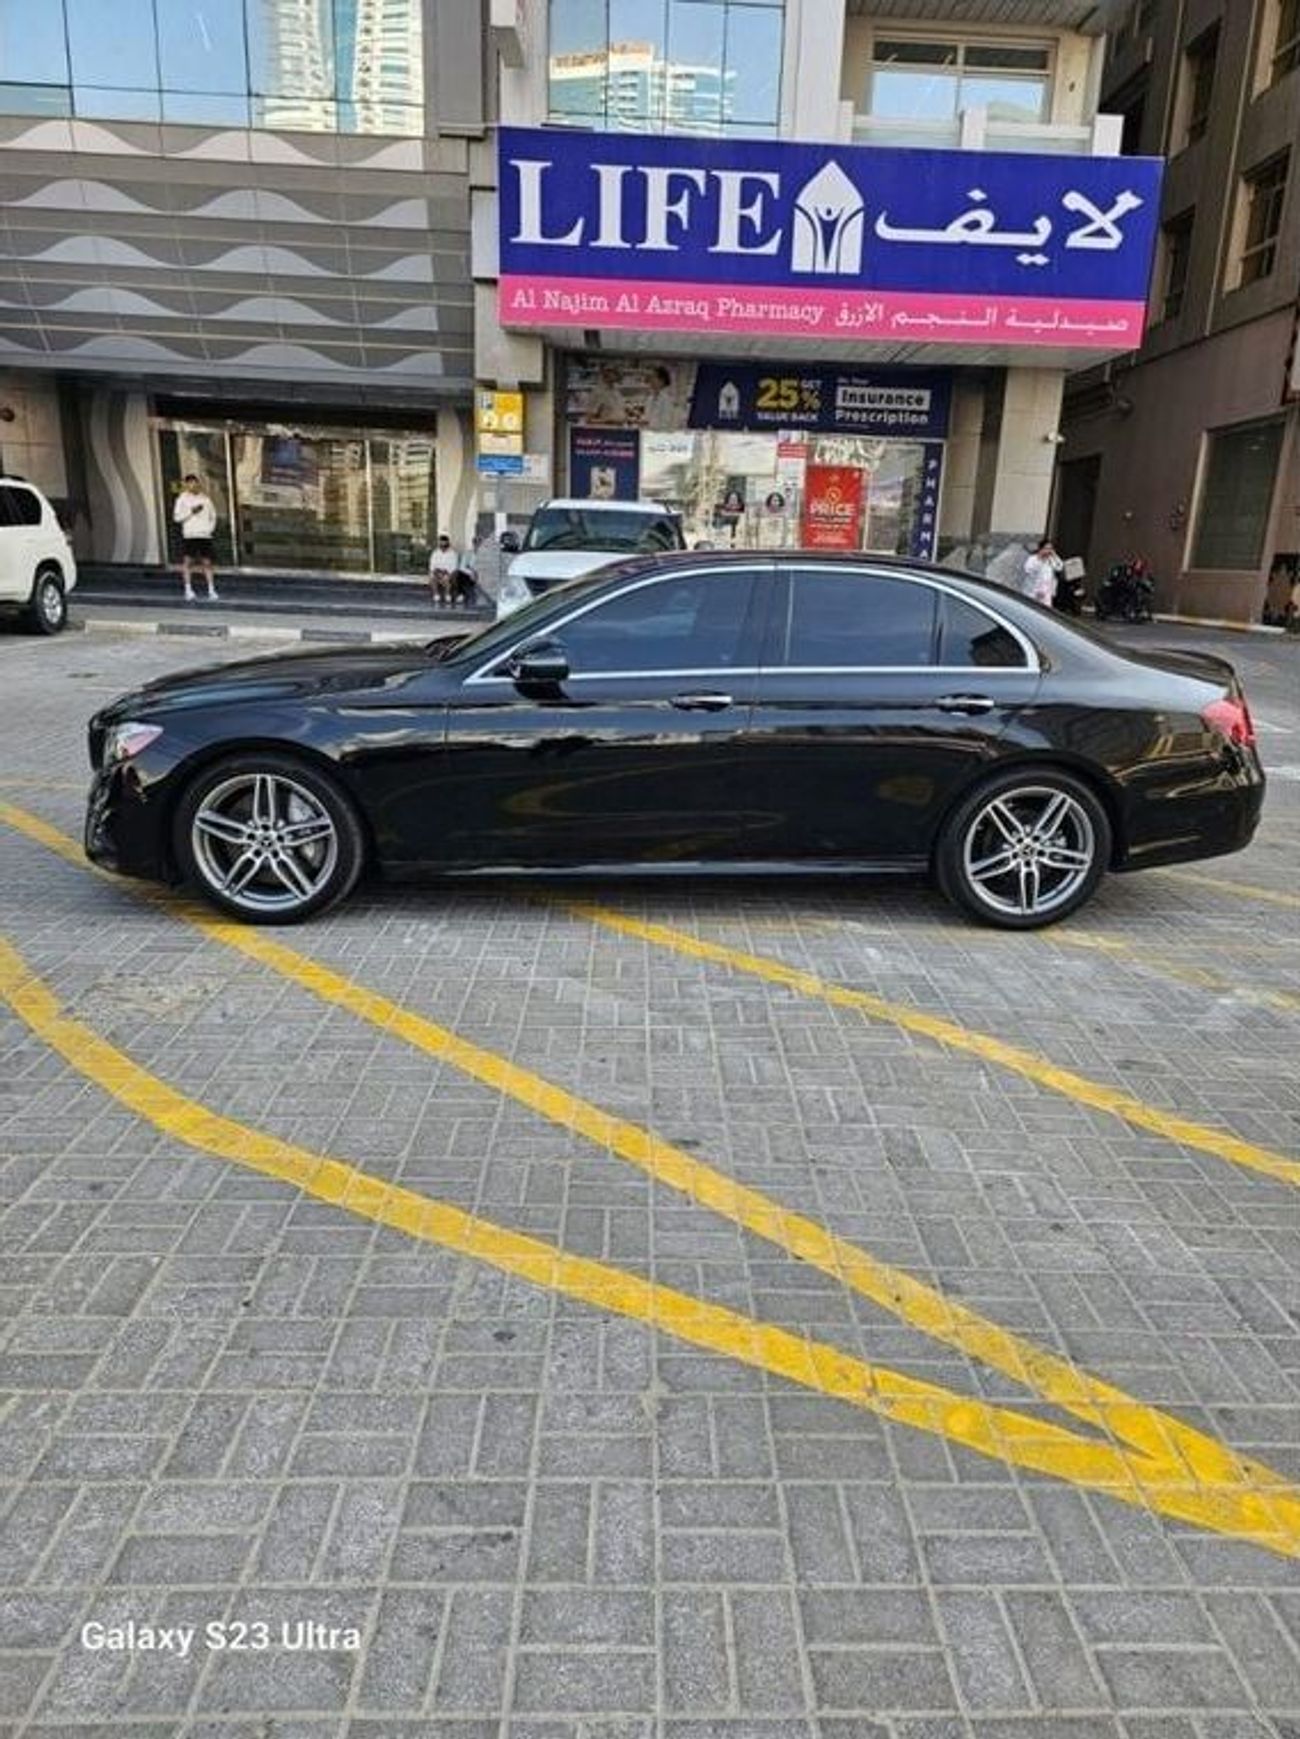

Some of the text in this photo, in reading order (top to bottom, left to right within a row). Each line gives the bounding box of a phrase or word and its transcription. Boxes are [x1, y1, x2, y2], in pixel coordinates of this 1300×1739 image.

[510, 159, 782, 257] LIFE
[875, 188, 1143, 266] لايف
[512, 288, 824, 324] Al Najim Al Azraq Pharmacy
[891, 306, 997, 329] النجم
[1005, 308, 1128, 336] صيدلية
[842, 389, 924, 406] Insurance
[835, 409, 928, 425] Prescription
[810, 500, 856, 516] PRICE
